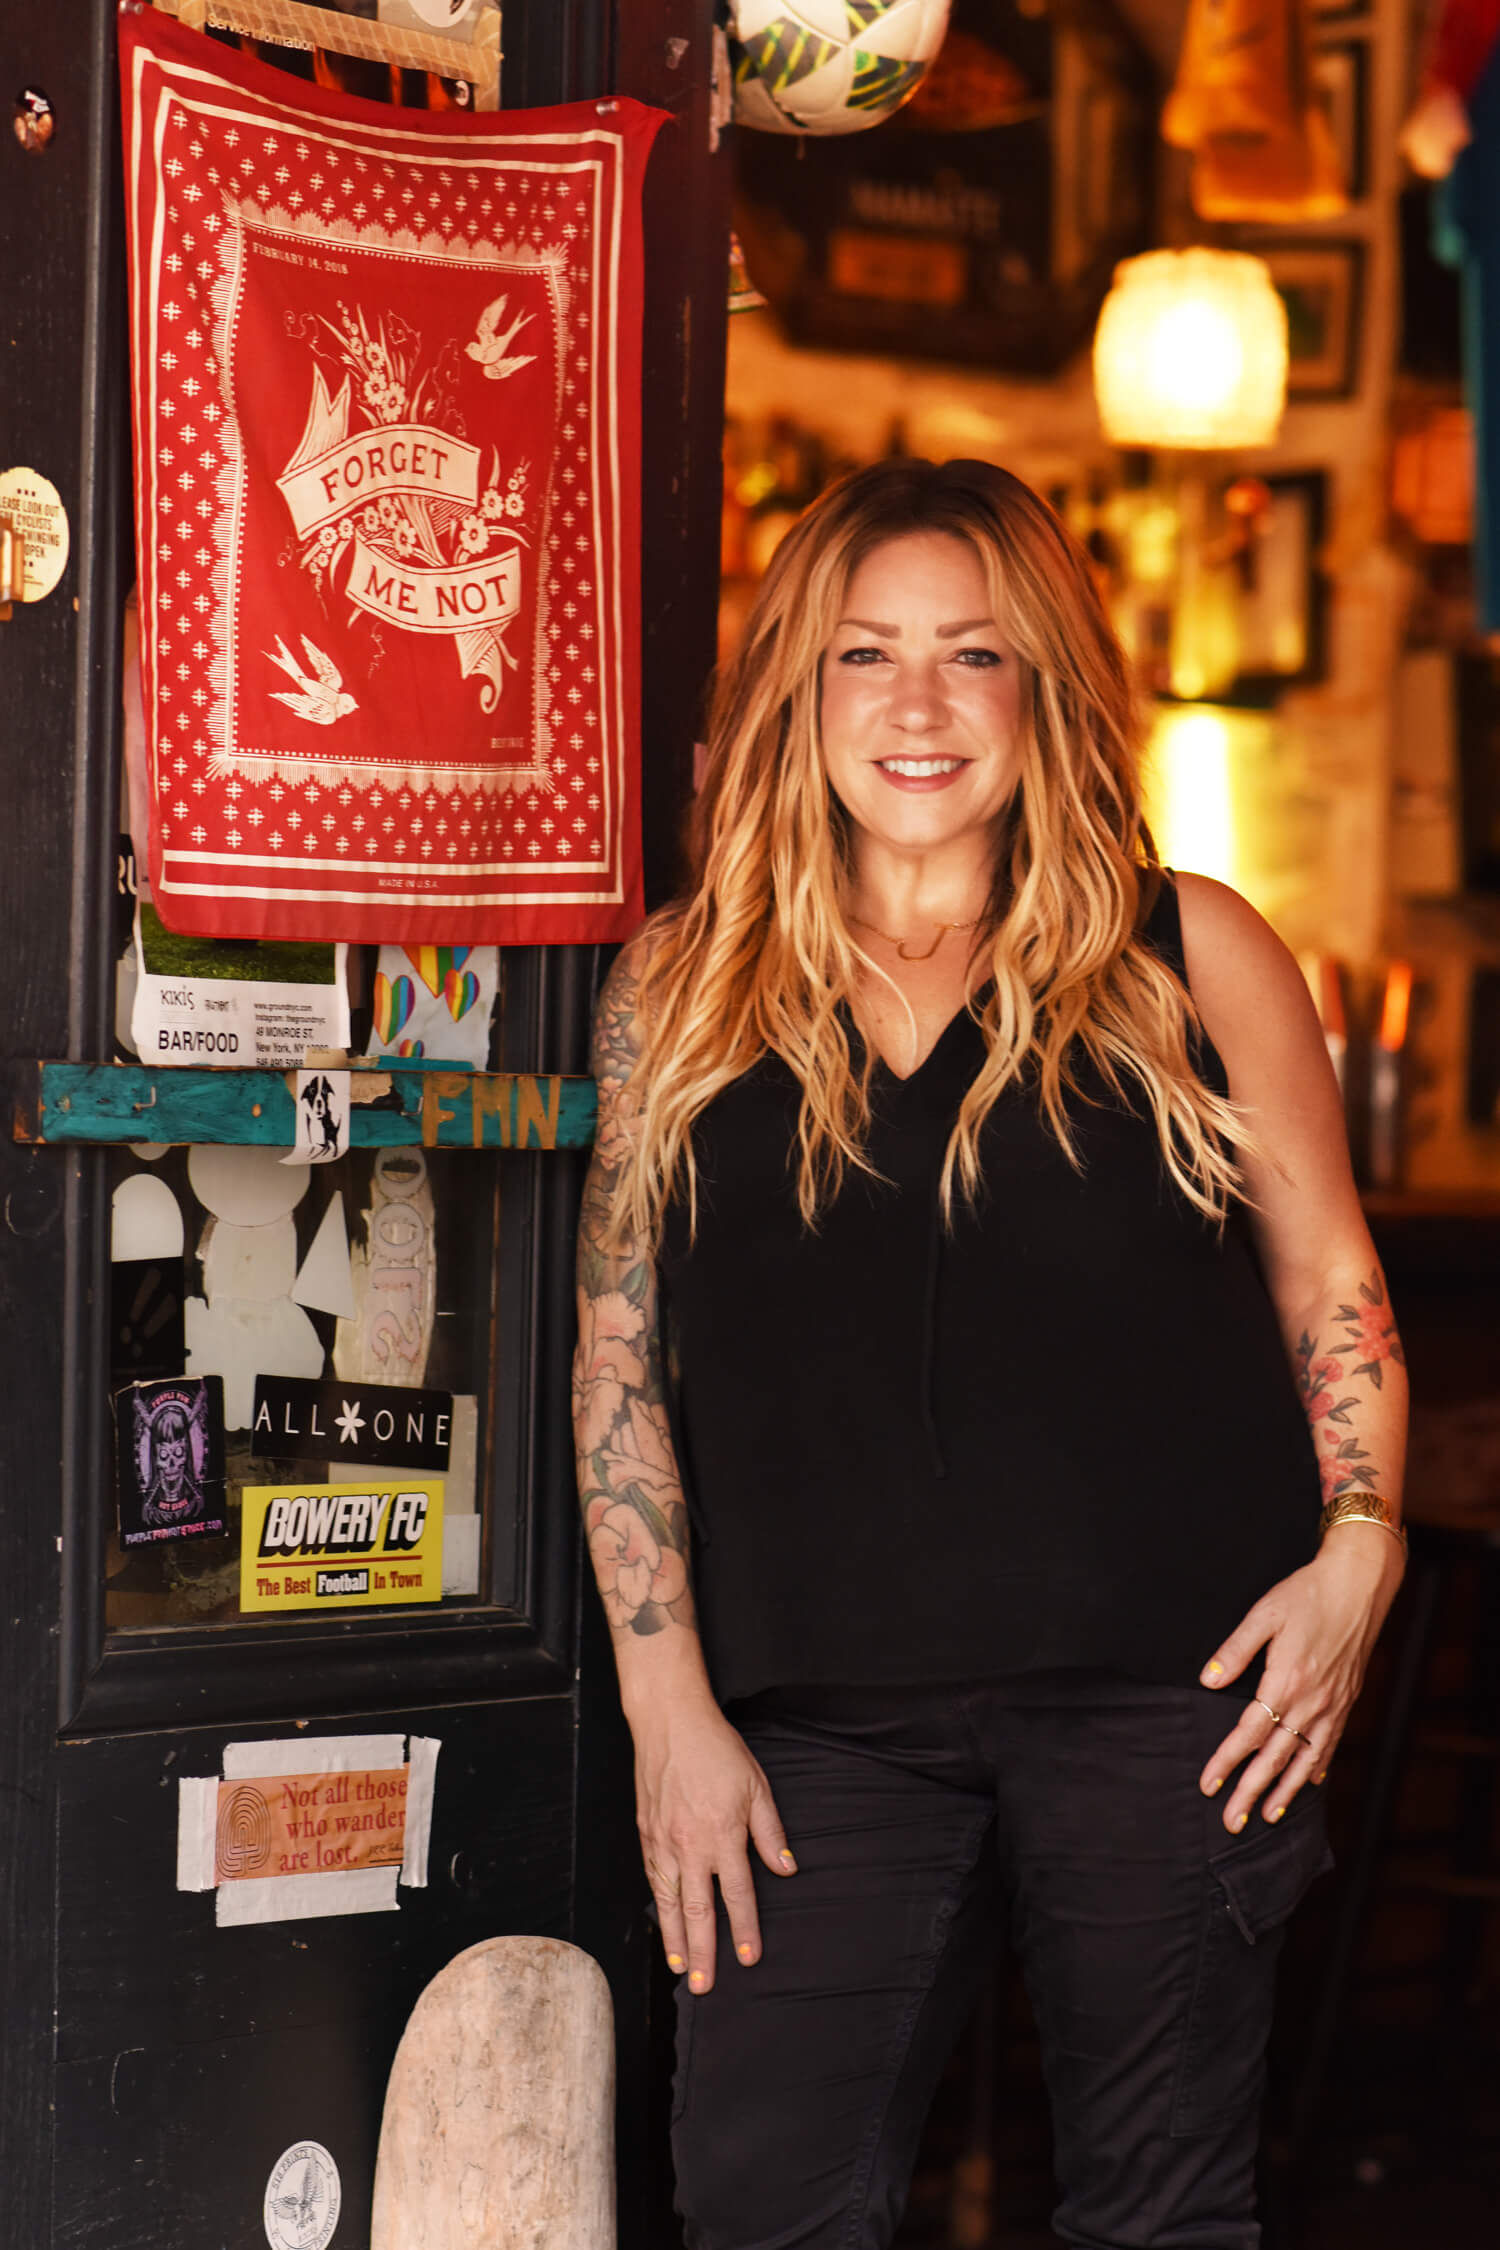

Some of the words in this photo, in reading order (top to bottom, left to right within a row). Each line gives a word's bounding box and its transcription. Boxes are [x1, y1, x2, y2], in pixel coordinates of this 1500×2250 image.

[320, 441, 448, 503] FORGET
[363, 565, 418, 614] ME
[435, 574, 508, 617] NOT
[158, 1028, 239, 1053] BAR/FOOD
[255, 1041, 271, 1053] New
[265, 1026, 301, 1039] MONROE
[253, 1399, 327, 1437] ALL
[373, 1409, 450, 1447] ONE
[258, 1492, 391, 1558] BOWERY
[384, 1491, 430, 1550] FC
[256, 1577, 281, 1597] The
[284, 1576, 312, 1596] Best
[317, 1571, 369, 1594] Football
[373, 1571, 386, 1590] In
[389, 1570, 423, 1590] Town
[280, 1781, 319, 1810] Not
[325, 1775, 349, 1805] all
[356, 1774, 407, 1800] those
[286, 1810, 328, 1841] who
[335, 1802, 406, 1834] wander
[279, 1852, 309, 1872] are
[316, 1839, 358, 1868] lost.
